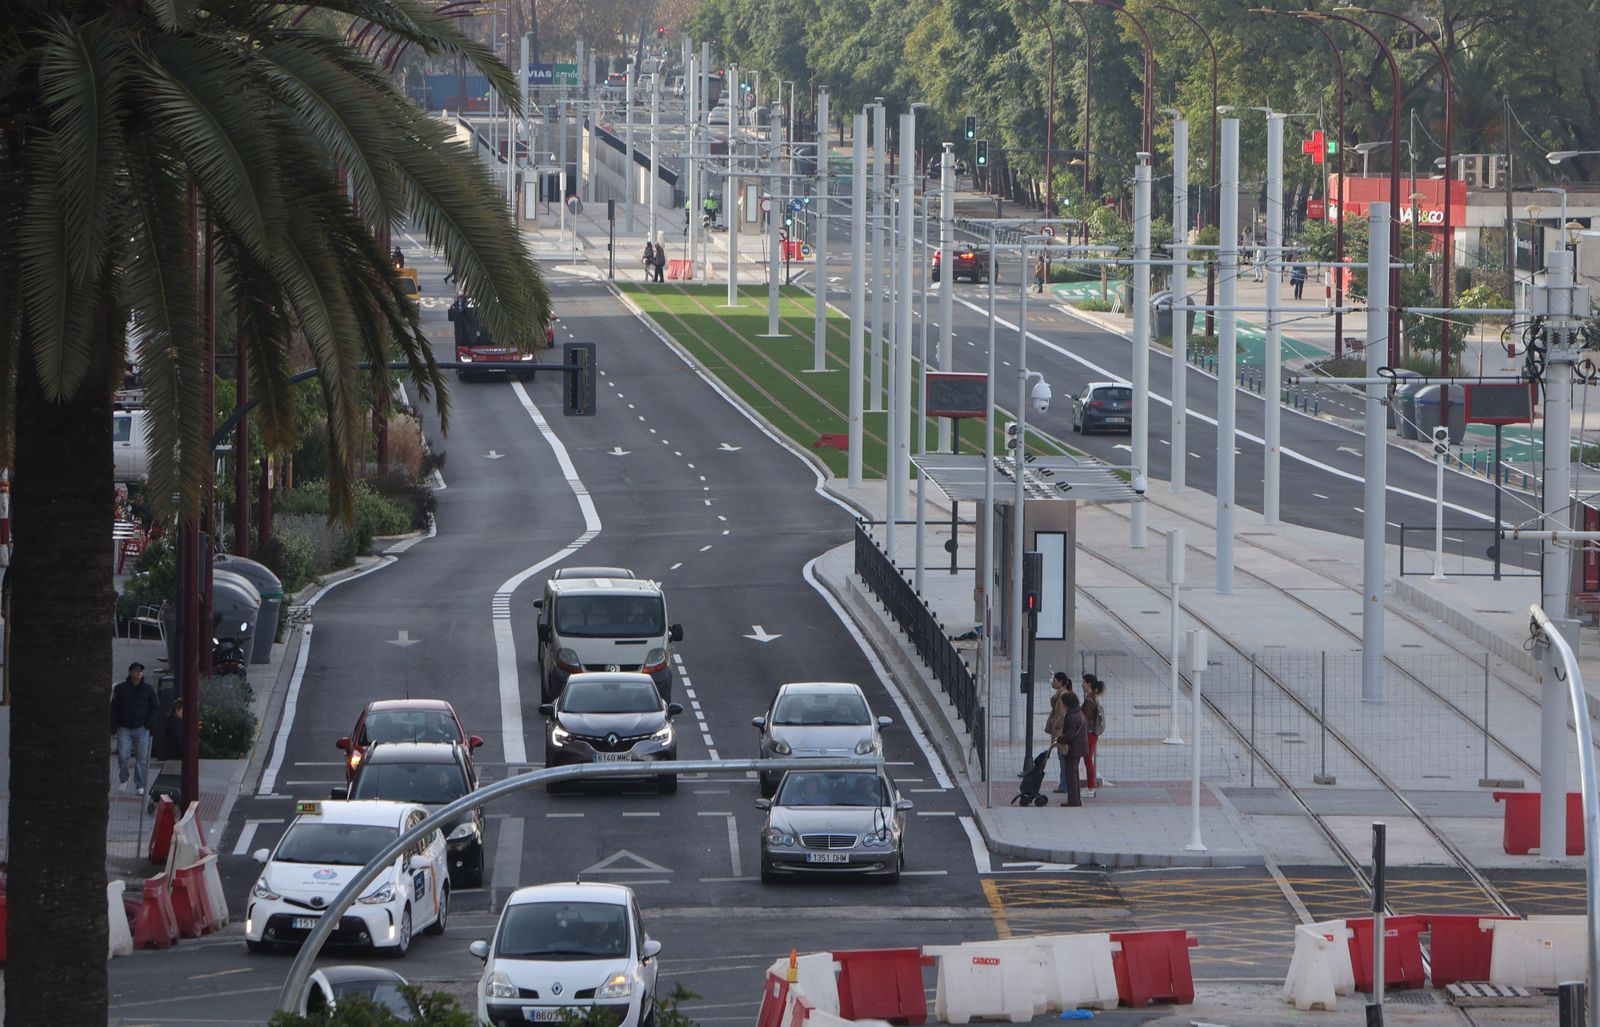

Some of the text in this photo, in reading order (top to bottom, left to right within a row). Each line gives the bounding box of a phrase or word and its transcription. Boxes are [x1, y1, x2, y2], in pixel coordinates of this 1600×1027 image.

[528, 70, 552, 78] VIAS
[813, 854, 830, 862] 1351
[536, 1011, 559, 1020] 8603
